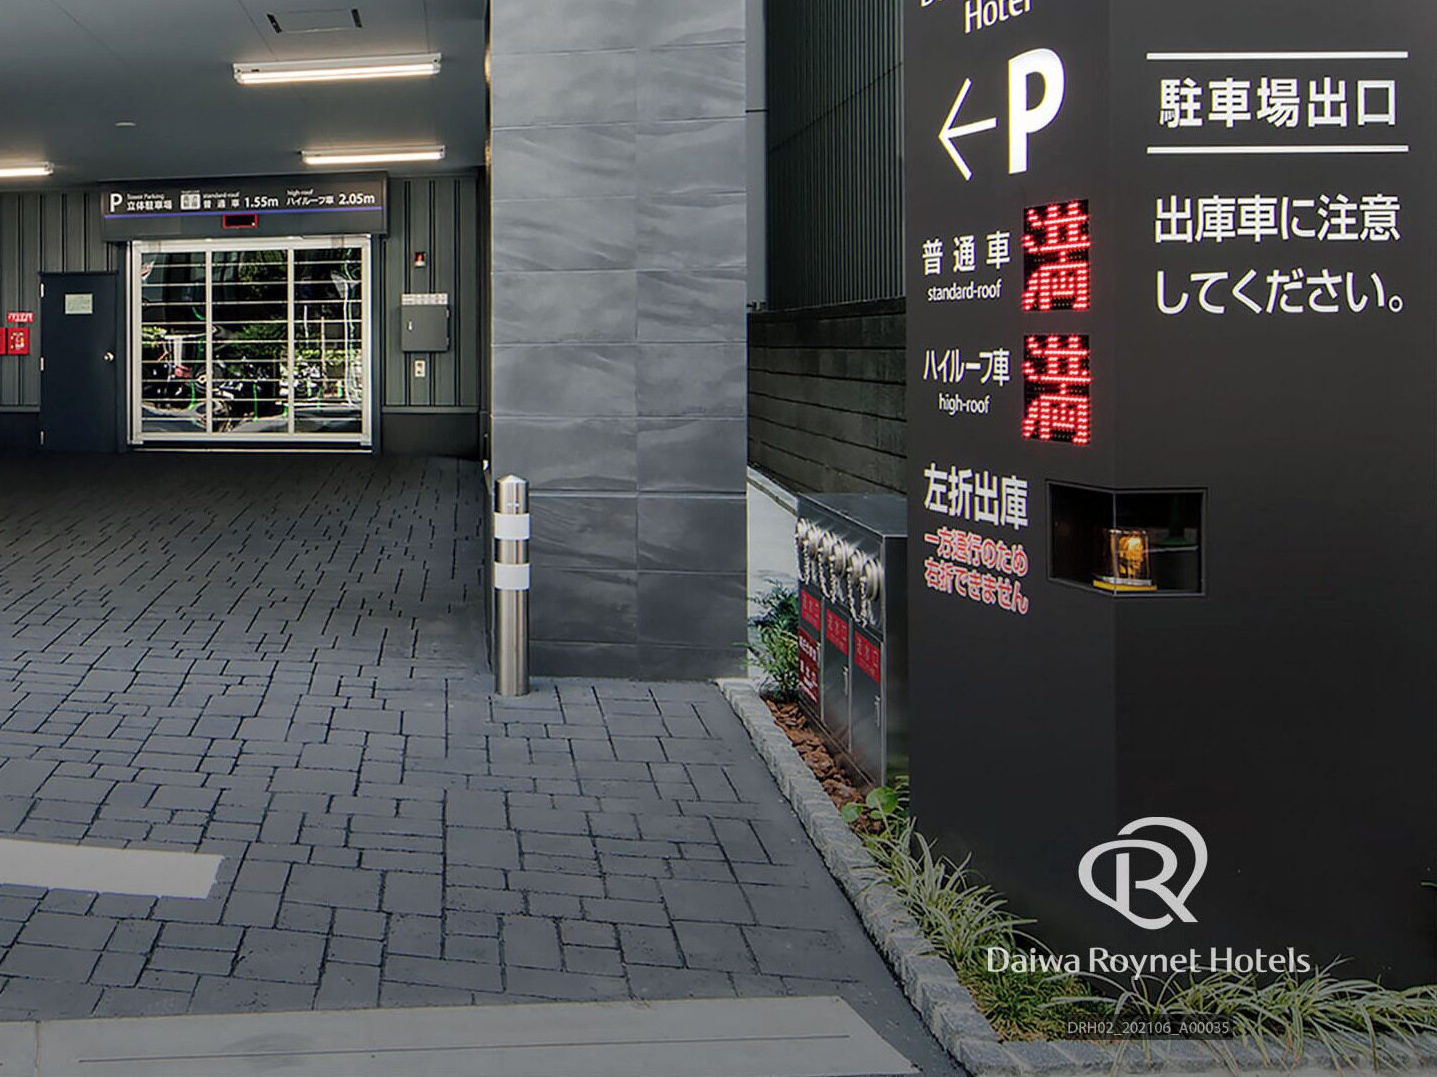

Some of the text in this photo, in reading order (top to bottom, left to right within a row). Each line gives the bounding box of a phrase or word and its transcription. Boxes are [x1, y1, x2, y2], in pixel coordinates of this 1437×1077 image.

[1008, 48, 1065, 175] P
[1159, 77, 1396, 128] 駐車場出口
[109, 193, 123, 213] P
[244, 196, 279, 208] 1.55m
[338, 193, 376, 206] 2.05m
[1155, 194, 1401, 243] 出庫車に注意
[922, 230, 1011, 276] 普通車
[928, 279, 1003, 302] standard-roof
[1157, 268, 1404, 315] してください。
[923, 348, 1011, 387] ハイルーフ車
[938, 393, 991, 416] high-roof
[924, 462, 1028, 530] 左折出庫
[924, 526, 1029, 577] 一方通行のため
[924, 556, 1030, 615] 右折できません
